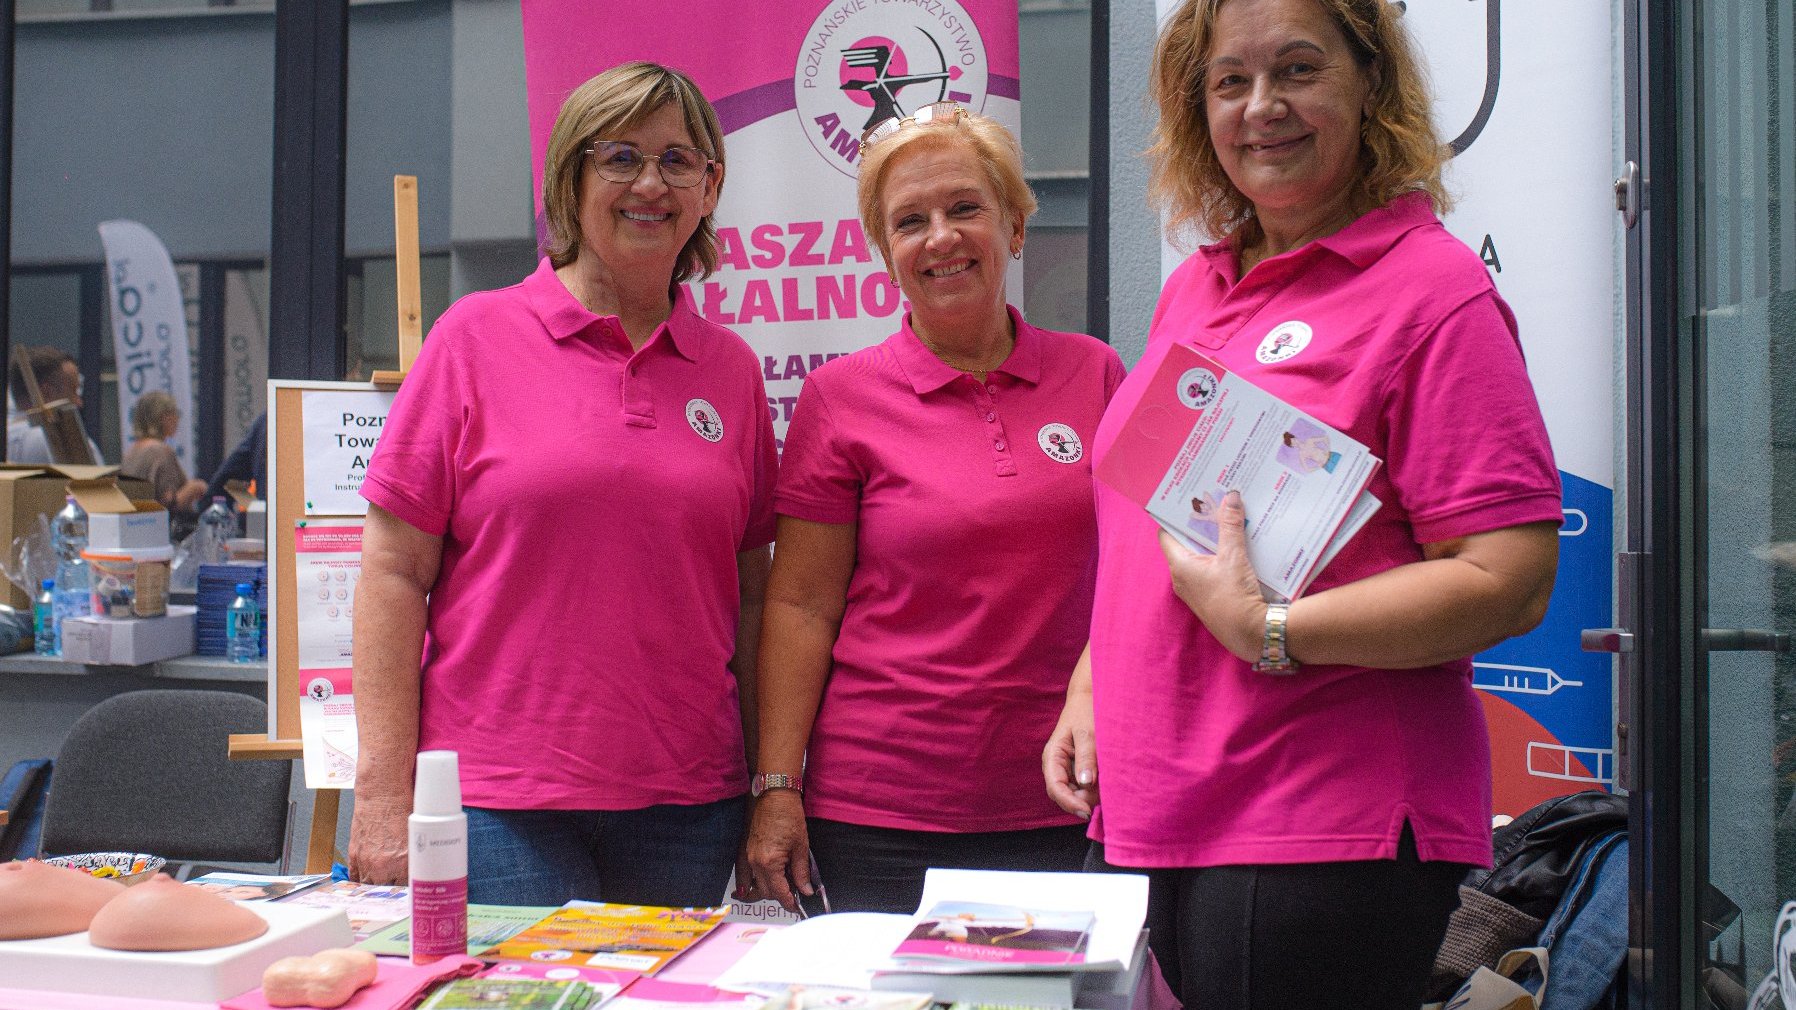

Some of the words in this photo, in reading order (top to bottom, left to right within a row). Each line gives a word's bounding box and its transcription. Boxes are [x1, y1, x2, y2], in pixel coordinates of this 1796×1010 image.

[803, 0, 867, 88] POZNAŃSKIE
[1194, 374, 1218, 408] AMAZONKI
[1045, 446, 1082, 462] AMAZONKI
